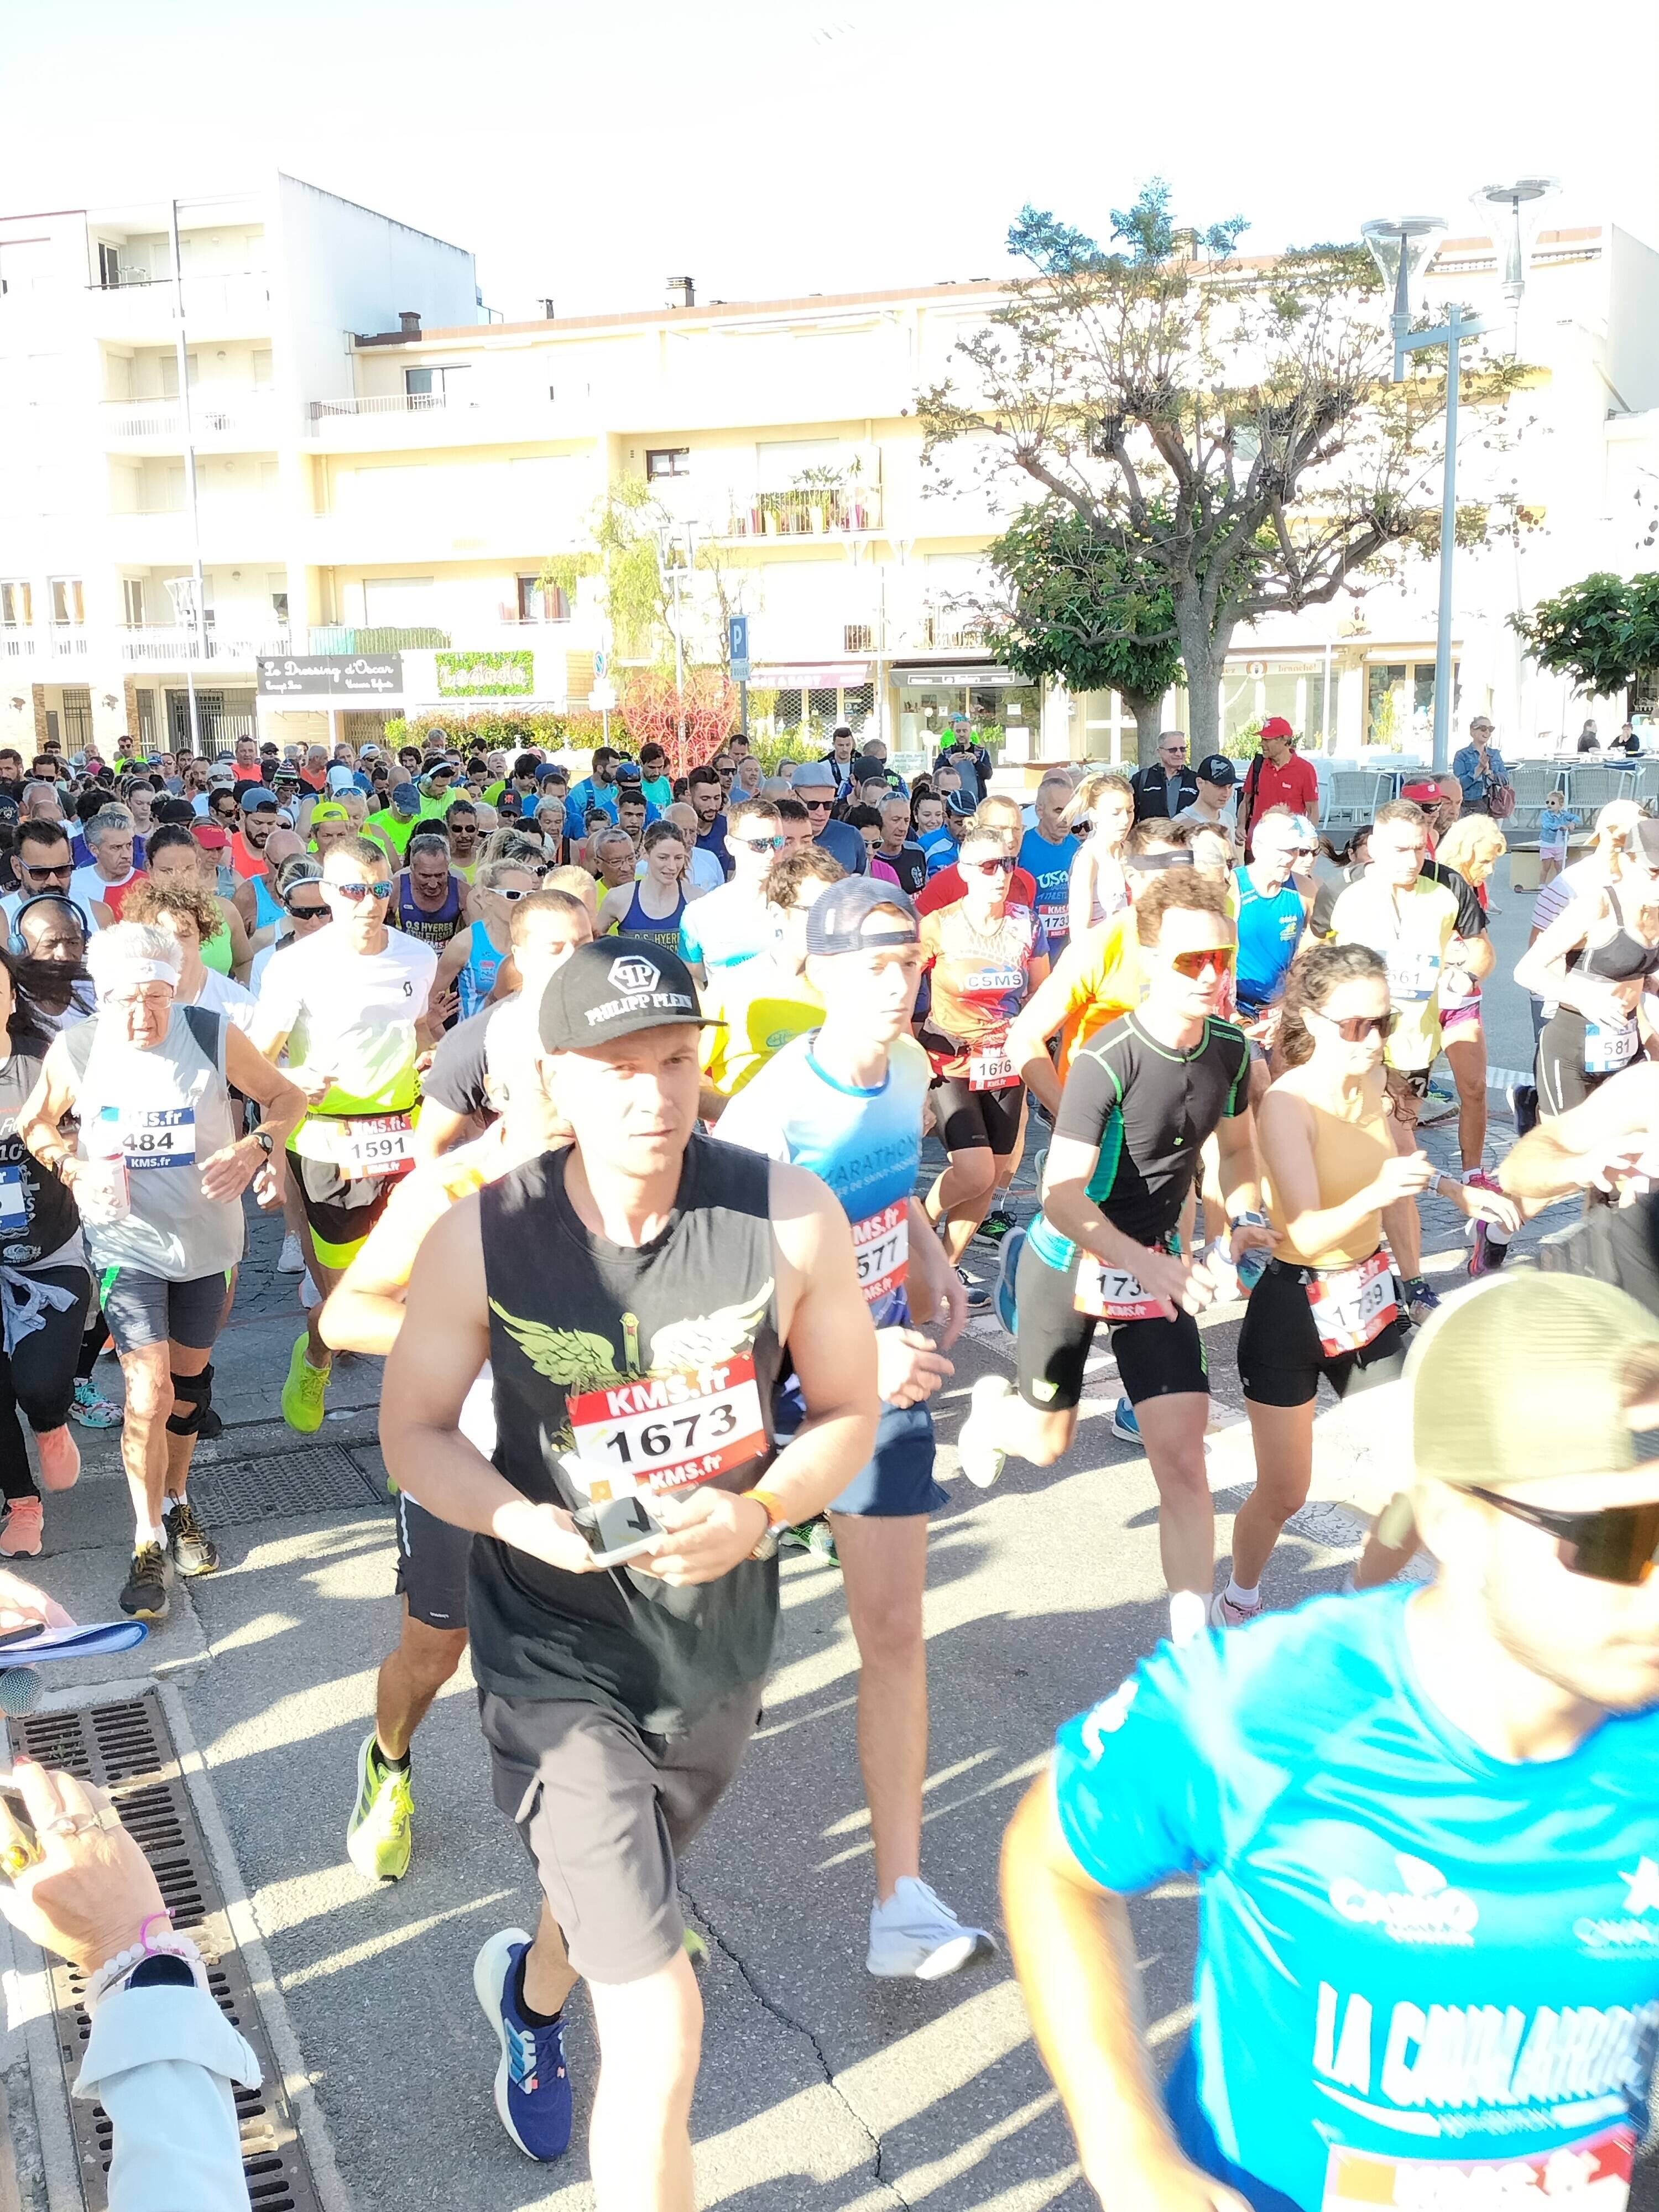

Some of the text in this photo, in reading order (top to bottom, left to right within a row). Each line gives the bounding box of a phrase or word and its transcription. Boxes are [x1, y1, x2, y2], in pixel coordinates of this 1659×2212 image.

[733, 625, 742, 653] P
[284, 660, 341, 683] Dressing
[345, 659, 394, 675] d'Oscar
[421, 921, 453, 932] HYERES
[968, 974, 1021, 987] CSMS
[584, 993, 693, 1027] PHILIPP PLEIN
[1604, 1038, 1630, 1055] 581
[979, 1059, 1012, 1076] 1616
[122, 1132, 174, 1151] 484
[351, 1137, 405, 1159] 1591
[131, 1157, 171, 1168] KMS.fr
[852, 1207, 900, 1245] MS.fr
[857, 1235, 898, 1279] 577
[605, 1363, 731, 1417] KMS.fr
[606, 1404, 737, 1464] 1673
[648, 1454, 723, 1490] KMS.fr
